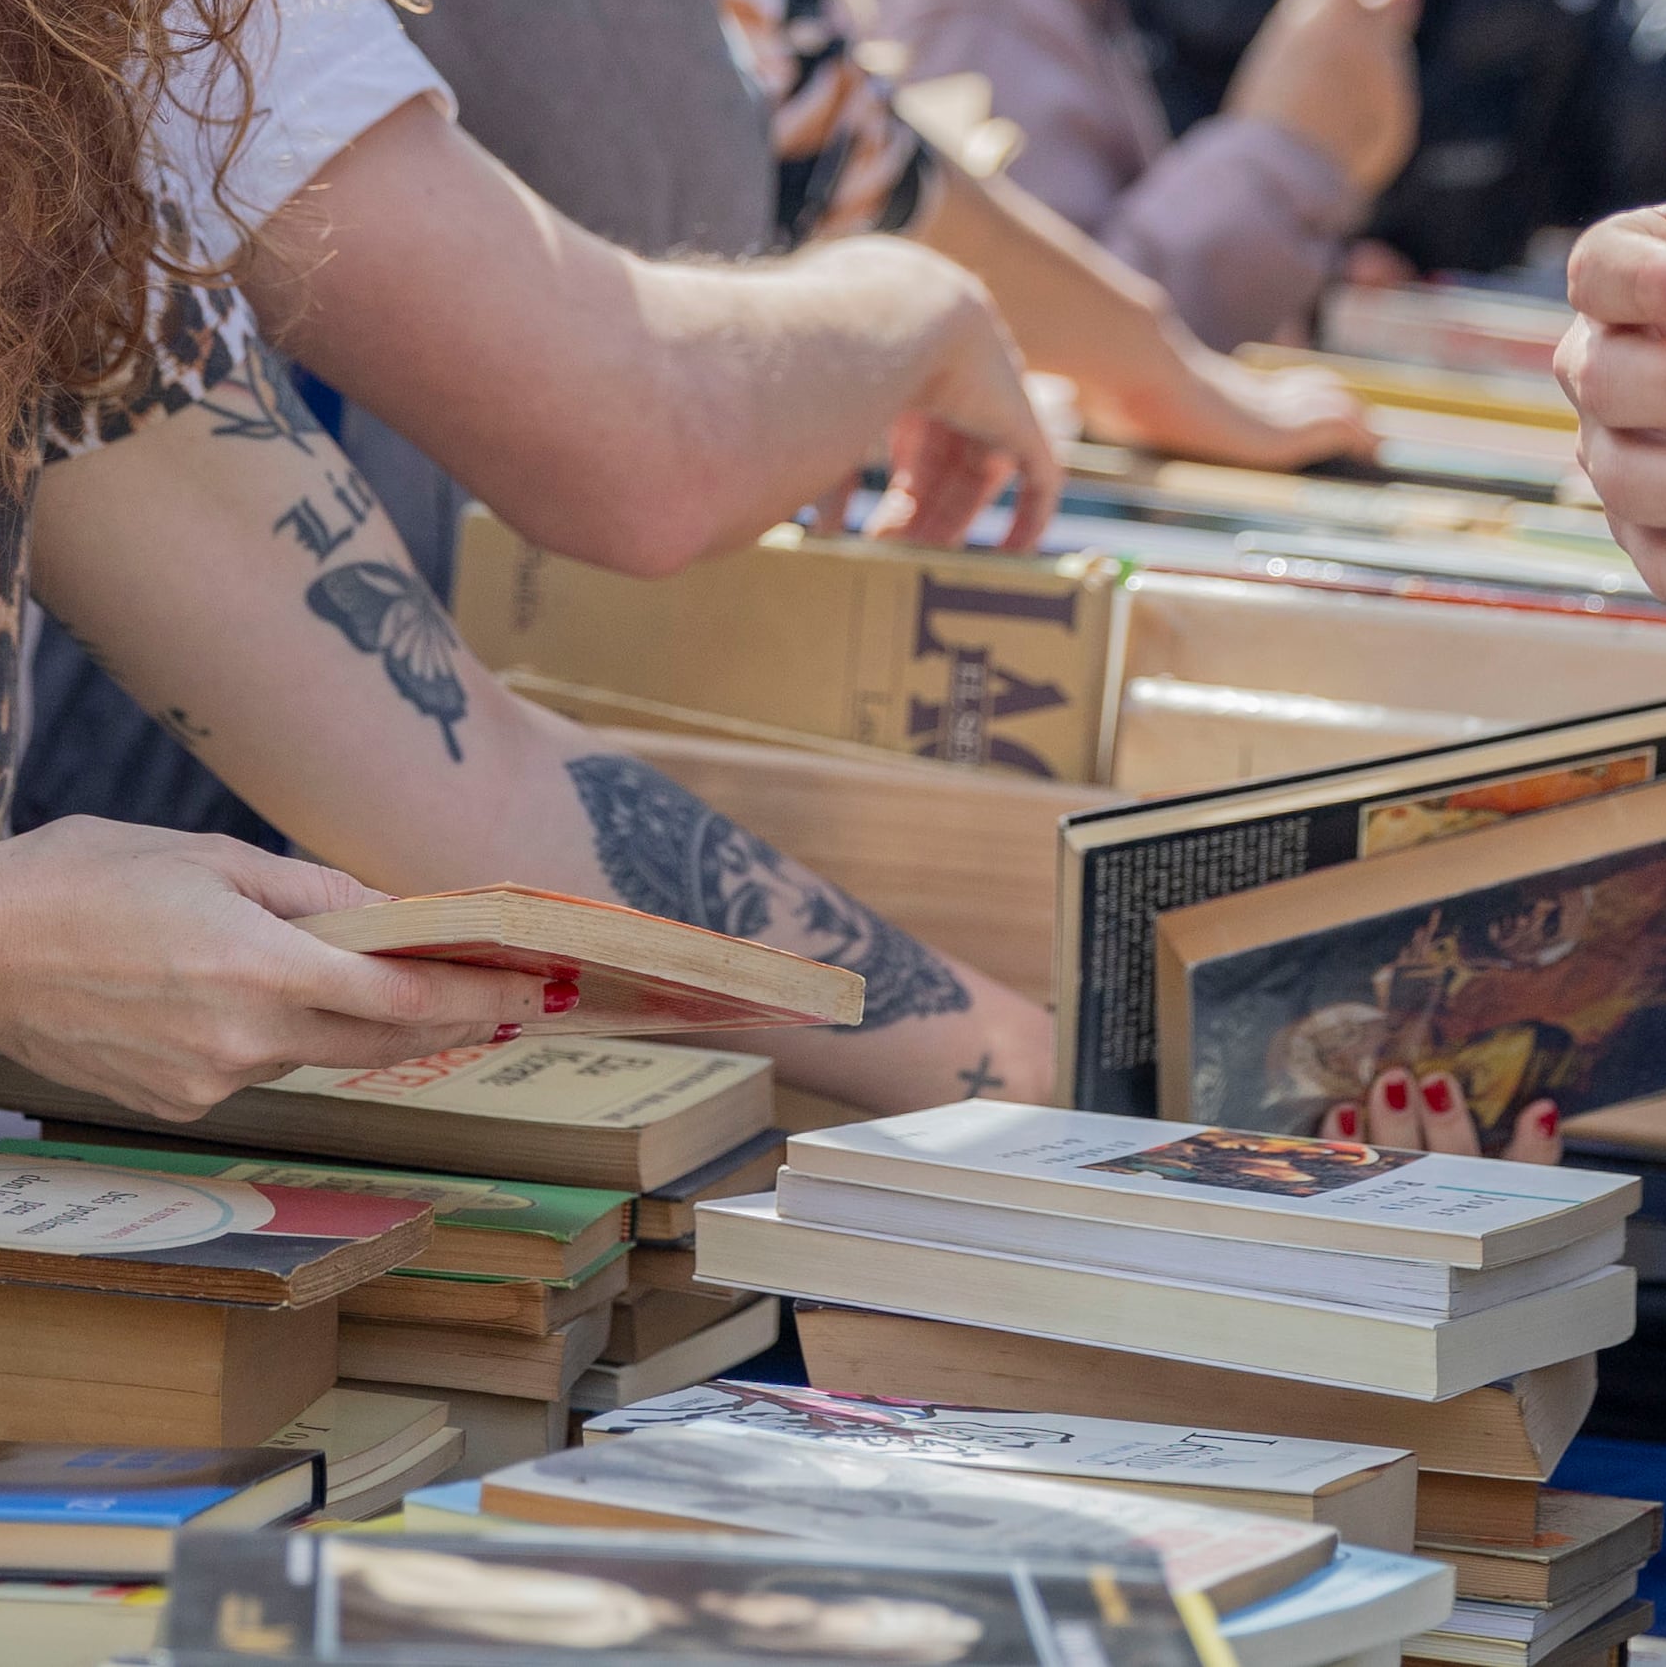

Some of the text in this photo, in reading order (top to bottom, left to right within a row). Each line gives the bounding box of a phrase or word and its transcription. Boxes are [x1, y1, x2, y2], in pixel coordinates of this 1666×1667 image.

[0, 1174, 52, 1190] don
[1331, 1179, 1427, 1205] BORGES
[2, 1198, 47, 1217] para
[16, 1190, 140, 1236] Seis problemas
[1379, 1195, 1443, 1211] LUIS
[1429, 1193, 1508, 1216] JORGE
